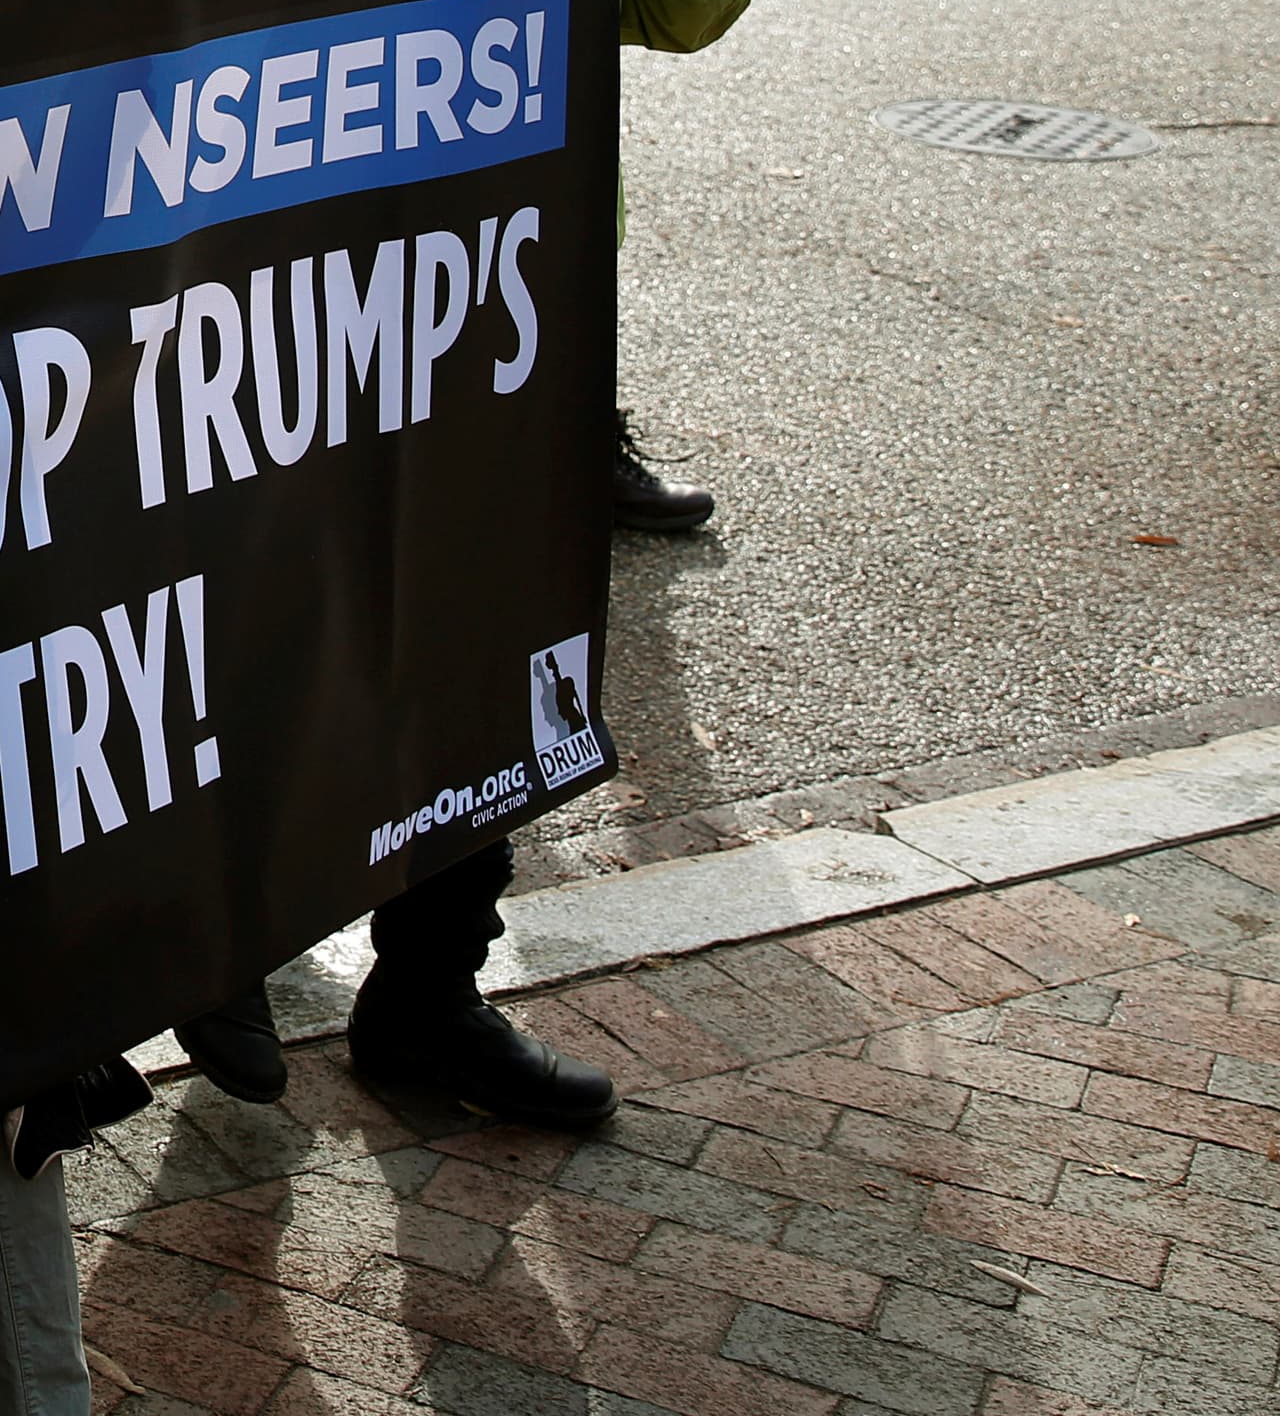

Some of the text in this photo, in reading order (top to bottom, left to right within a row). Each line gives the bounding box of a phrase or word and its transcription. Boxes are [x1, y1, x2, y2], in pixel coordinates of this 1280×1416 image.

[103, 10, 545, 218] NSEERS!
[129, 206, 540, 510] TRUMP'S
[538, 731, 599, 779] DRUM
[368, 761, 526, 867] MoveOn.ORG
[471, 790, 528, 829] CIVIC ACTION
